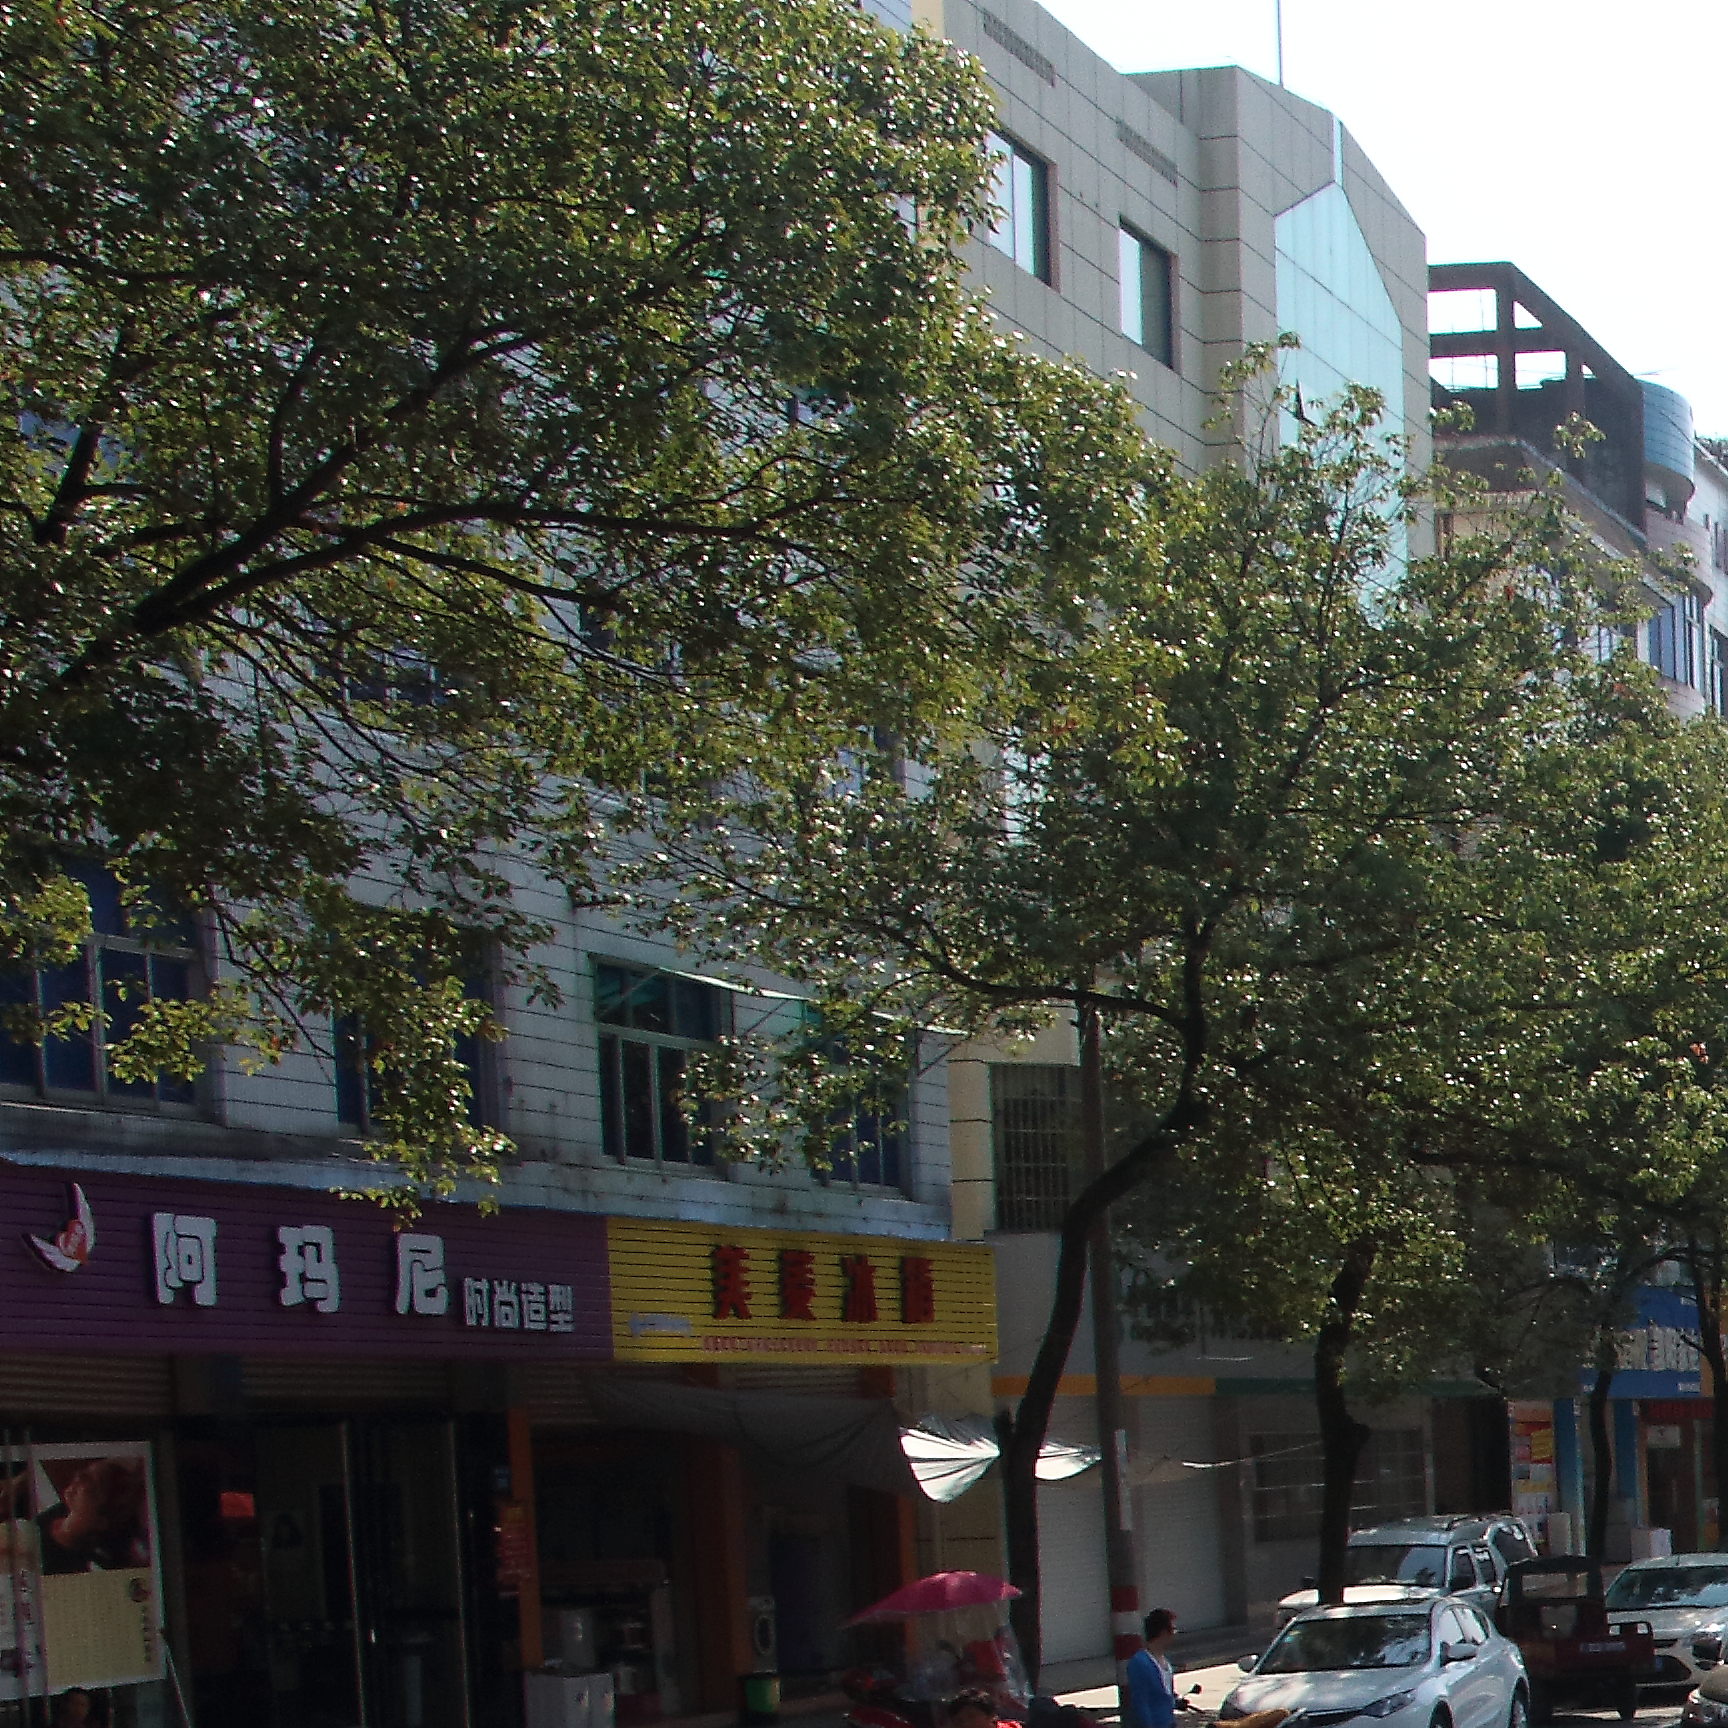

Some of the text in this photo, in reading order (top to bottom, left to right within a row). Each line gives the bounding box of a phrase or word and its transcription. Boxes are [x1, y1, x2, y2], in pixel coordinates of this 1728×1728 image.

[151, 1211, 450, 1315] 阿玛尼
[463, 1276, 575, 1334] 时尚造型
